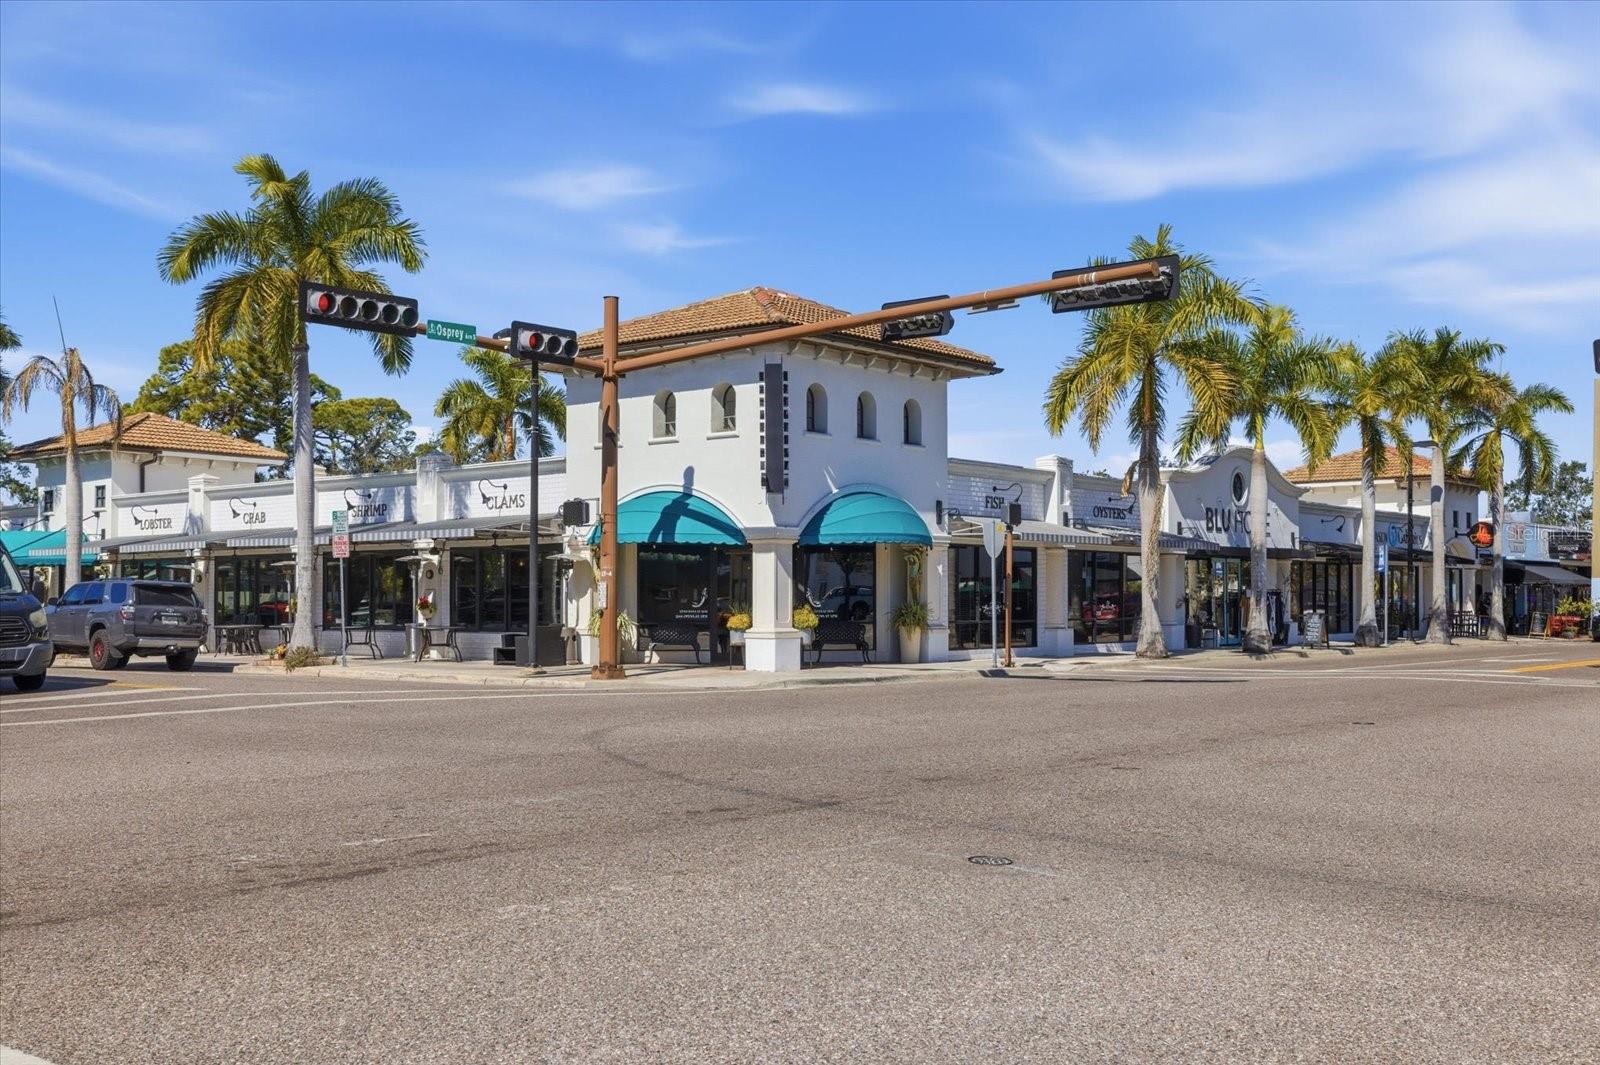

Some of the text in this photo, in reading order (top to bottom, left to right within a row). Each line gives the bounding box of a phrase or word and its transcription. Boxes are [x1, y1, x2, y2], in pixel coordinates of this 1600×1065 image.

[436, 323, 464, 341] Osprey
[486, 494, 525, 510] CLAMS
[242, 511, 266, 525] CRAB
[352, 503, 388, 518] SHRIMP
[1092, 505, 1127, 520] OYSTERS
[140, 517, 173, 530] LOBSTER
[1205, 507, 1231, 533] BLU
